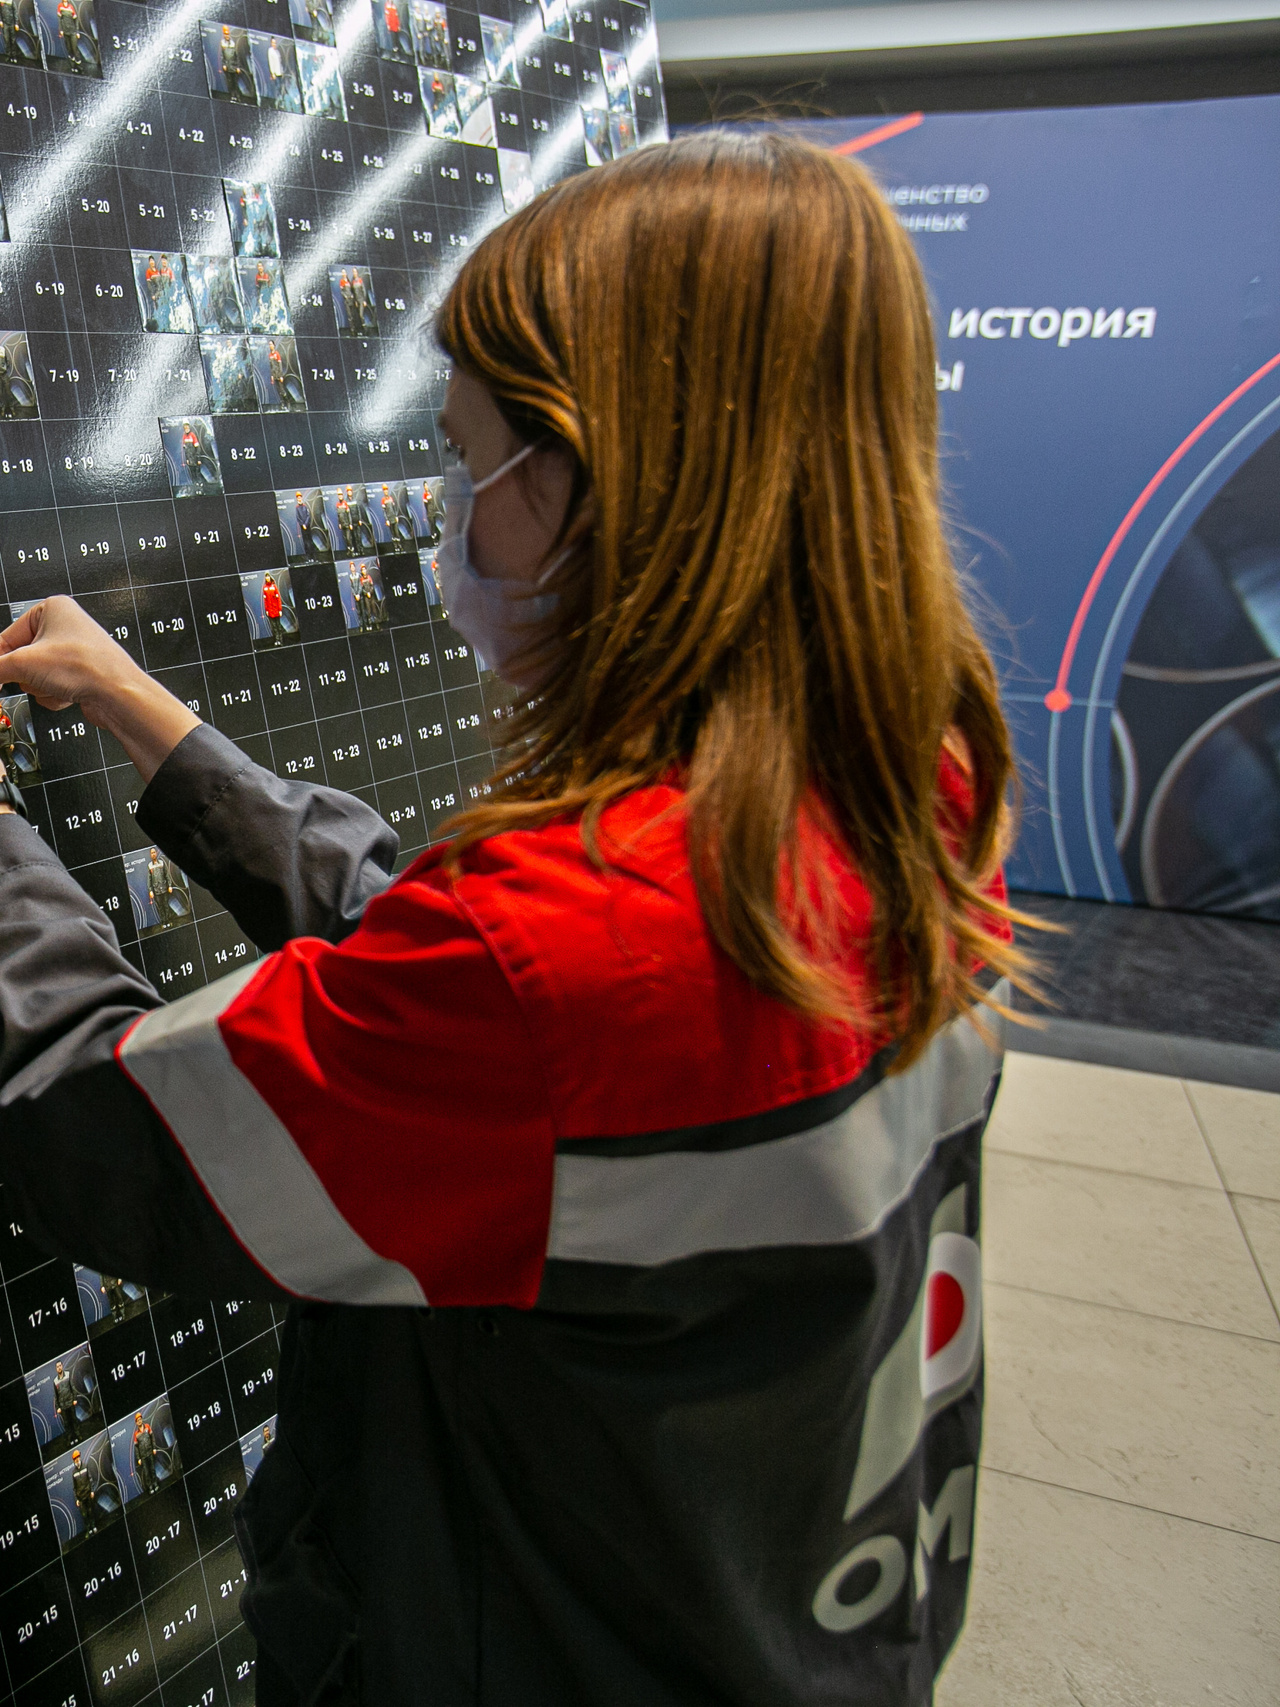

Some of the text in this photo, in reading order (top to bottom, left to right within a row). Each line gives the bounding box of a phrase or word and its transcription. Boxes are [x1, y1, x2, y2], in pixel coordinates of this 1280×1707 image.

[112, 35, 138, 50] 3-21
[353, 82, 374, 96] 3-26
[8, 104, 37, 119] 4-19
[229, 134, 252, 149] 4-23
[886, 183, 990, 206] енство
[82, 199, 109, 213] 5-20
[190, 208, 215, 222] 5-22
[36, 282, 64, 295] 6-19
[300, 294, 322, 305] 6-24
[948, 306, 1157, 348] история
[50, 370, 79, 382] 7-19
[231, 448, 256, 460] 8-22
[368, 441, 389, 452] 8-25
[2, 459, 33, 473] 8-18
[245, 526, 270, 538] 9-22
[81, 542, 109, 556] 9-19
[305, 596, 332, 609] 10-23
[152, 618, 184, 633] 10-20
[222, 690, 251, 705] 11-21
[49, 723, 85, 741] 11-18
[286, 756, 315, 773] 12-22
[66, 810, 102, 829] 12-18
[215, 943, 246, 963] 14-20
[160, 962, 192, 983] 14-19
[29, 1298, 67, 1327] 17-16
[171, 1319, 204, 1346] 18-18
[111, 1351, 145, 1380] 18-17
[242, 1369, 273, 1395] 19-19
[204, 1484, 237, 1515] 20-18
[0, 1514, 39, 1548] 19-15
[146, 1521, 179, 1554] 20-17
[164, 1604, 196, 1639] 21-17
[103, 1649, 139, 1685] 21-16
